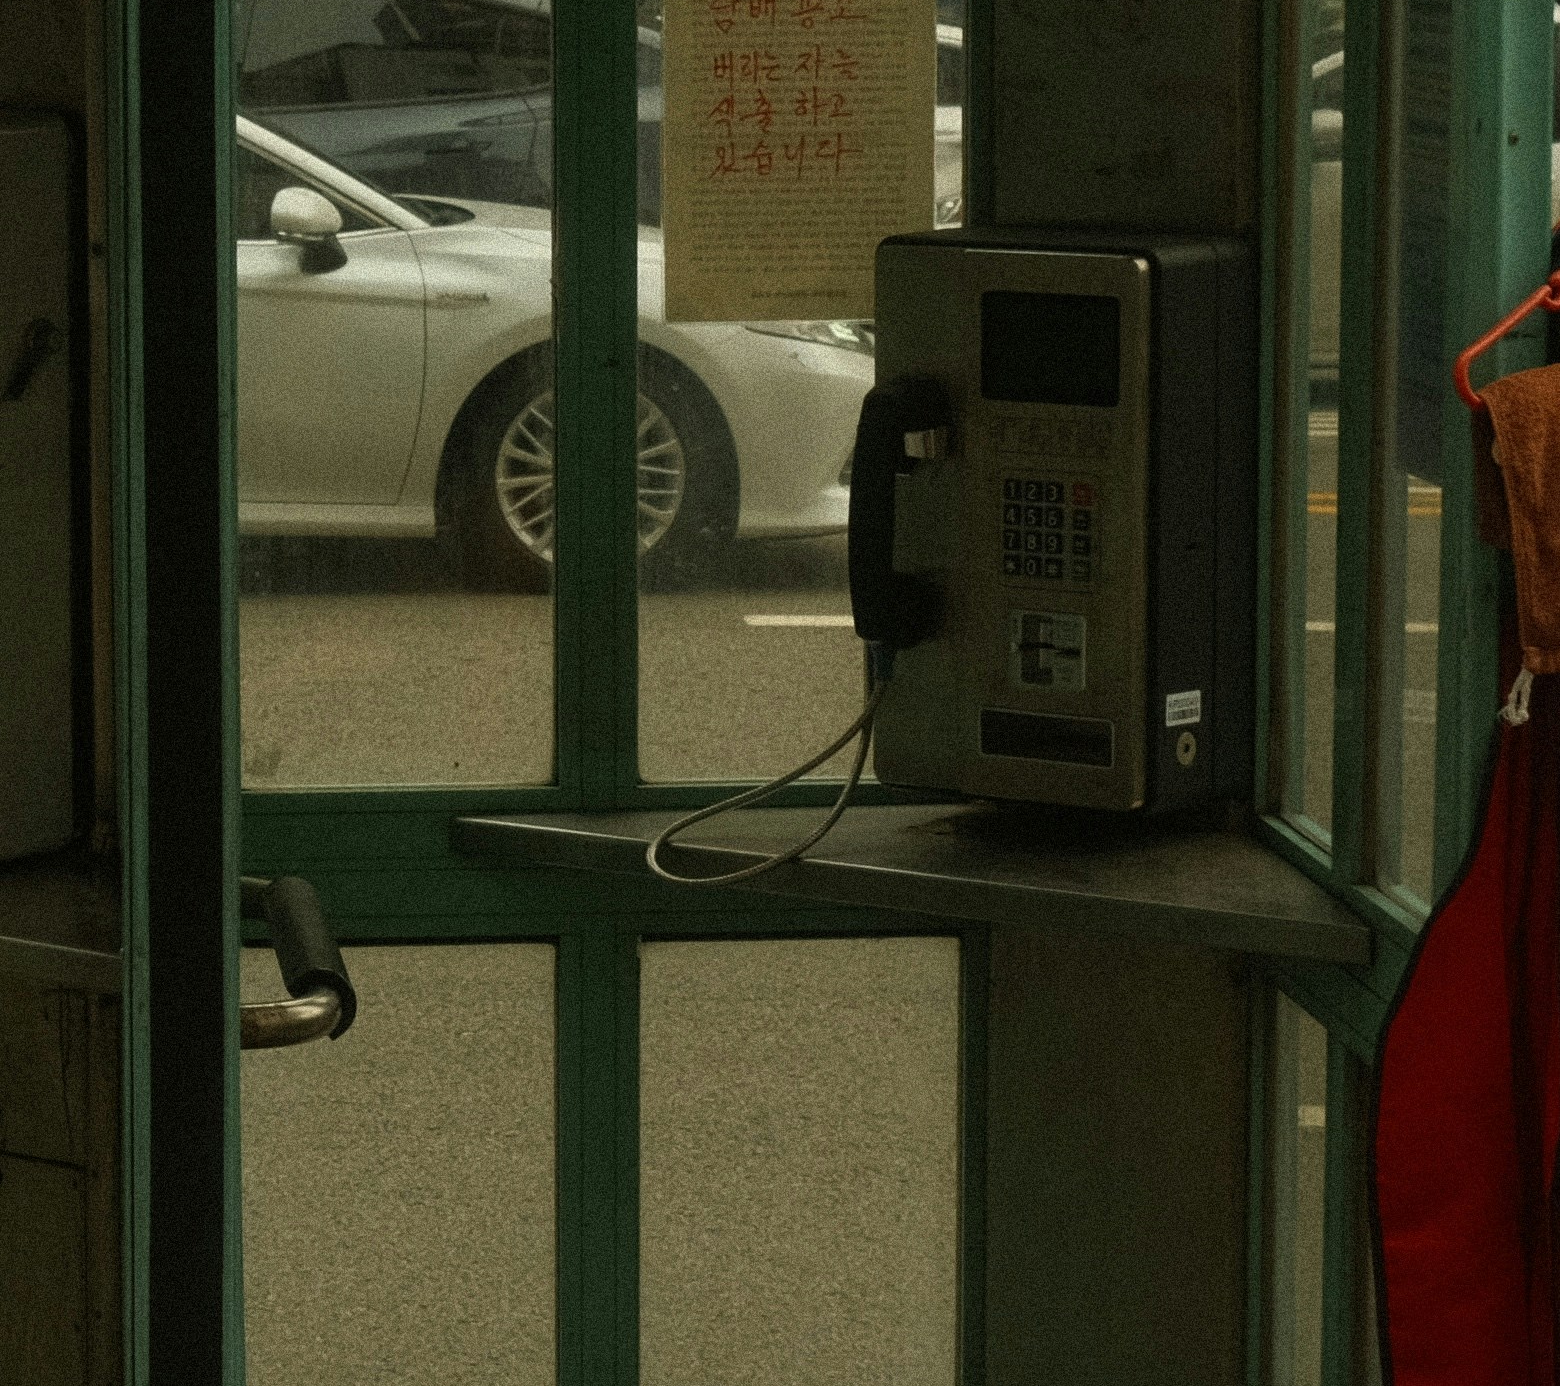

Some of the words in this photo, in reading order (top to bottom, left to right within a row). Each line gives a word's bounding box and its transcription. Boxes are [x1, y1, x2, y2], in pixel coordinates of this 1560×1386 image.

[713, 50, 782, 92] 버리는
[794, 86, 853, 127] 하고
[709, 132, 863, 180] 있습니다
[1027, 483, 1038, 500] 2
[1027, 509, 1037, 525] 5
[1048, 511, 1058, 527] 6
[1027, 535, 1037, 551] 8
[1048, 536, 1059, 551] 9
